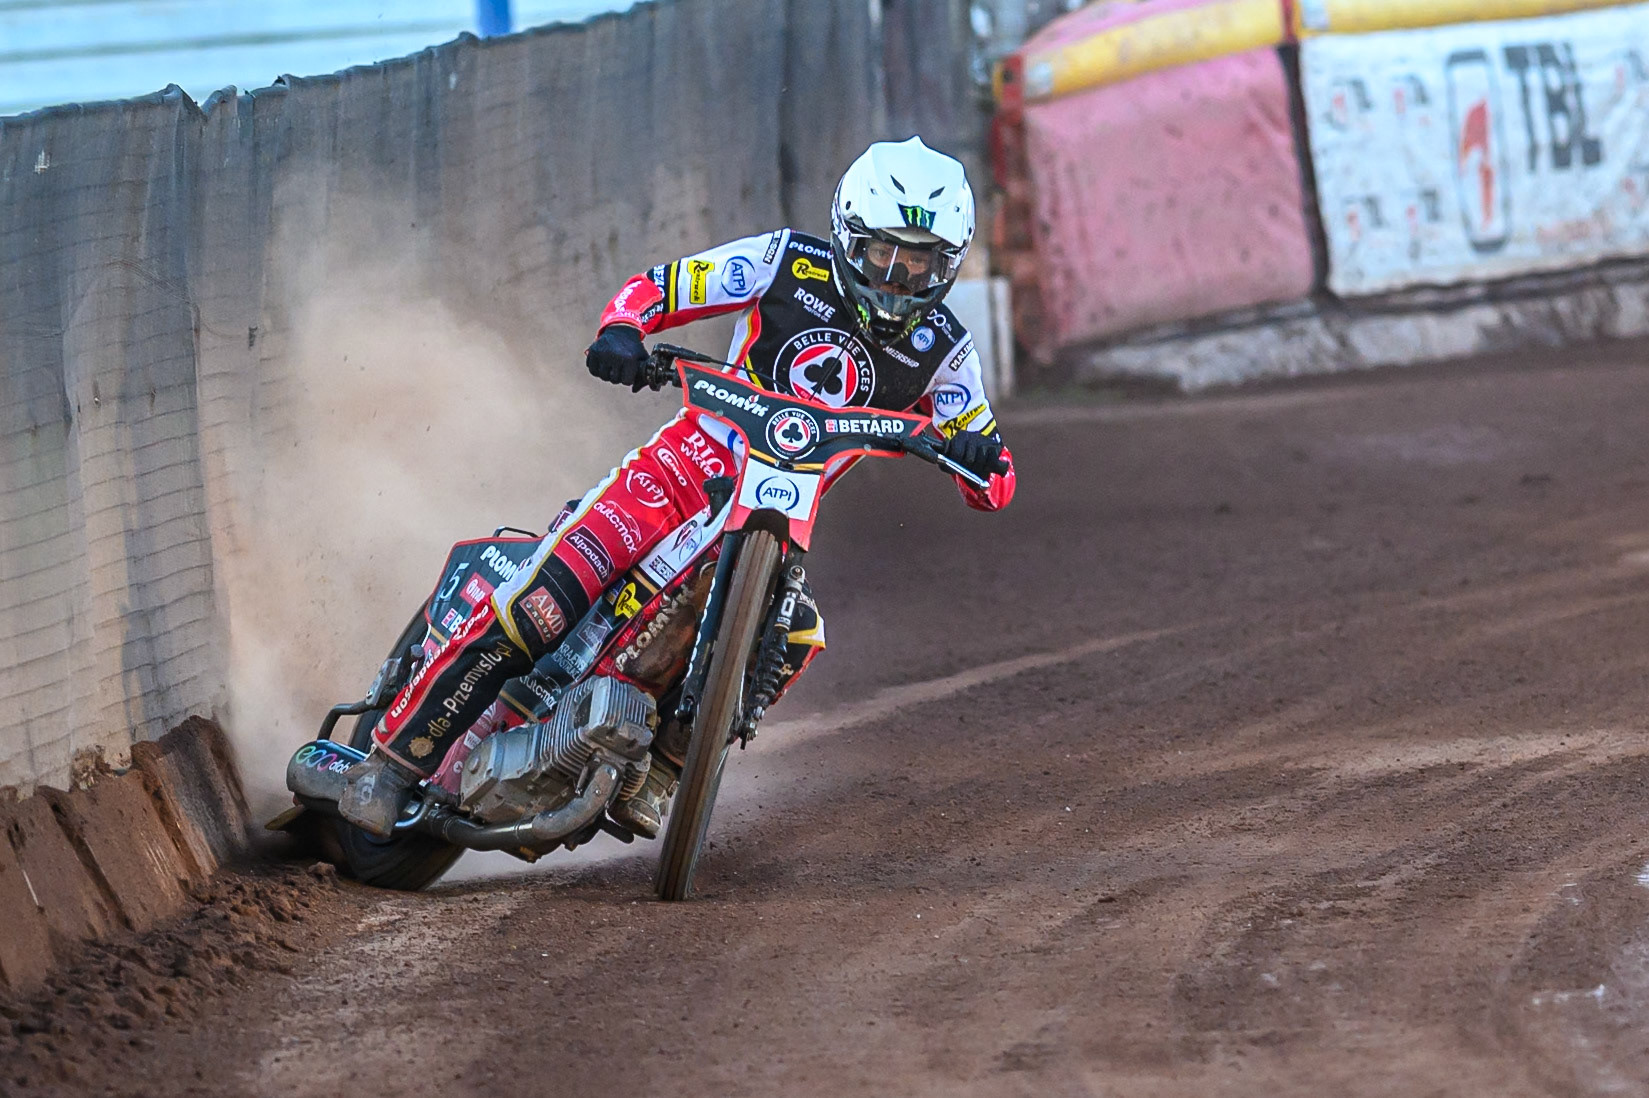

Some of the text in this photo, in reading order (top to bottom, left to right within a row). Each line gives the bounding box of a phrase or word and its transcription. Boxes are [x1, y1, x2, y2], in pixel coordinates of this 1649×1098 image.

[732, 262, 746, 291] ATPI
[793, 287, 836, 319] ROWE
[793, 333, 870, 392] BELLE VUE ACES
[936, 391, 964, 405] ATPI
[771, 411, 817, 435] BELLE VUE ACES
[838, 419, 905, 434] BETARD
[762, 486, 793, 501] ATPI
[569, 534, 608, 579] Alpodach
[440, 562, 470, 599] 5
[531, 593, 565, 634] AMD
